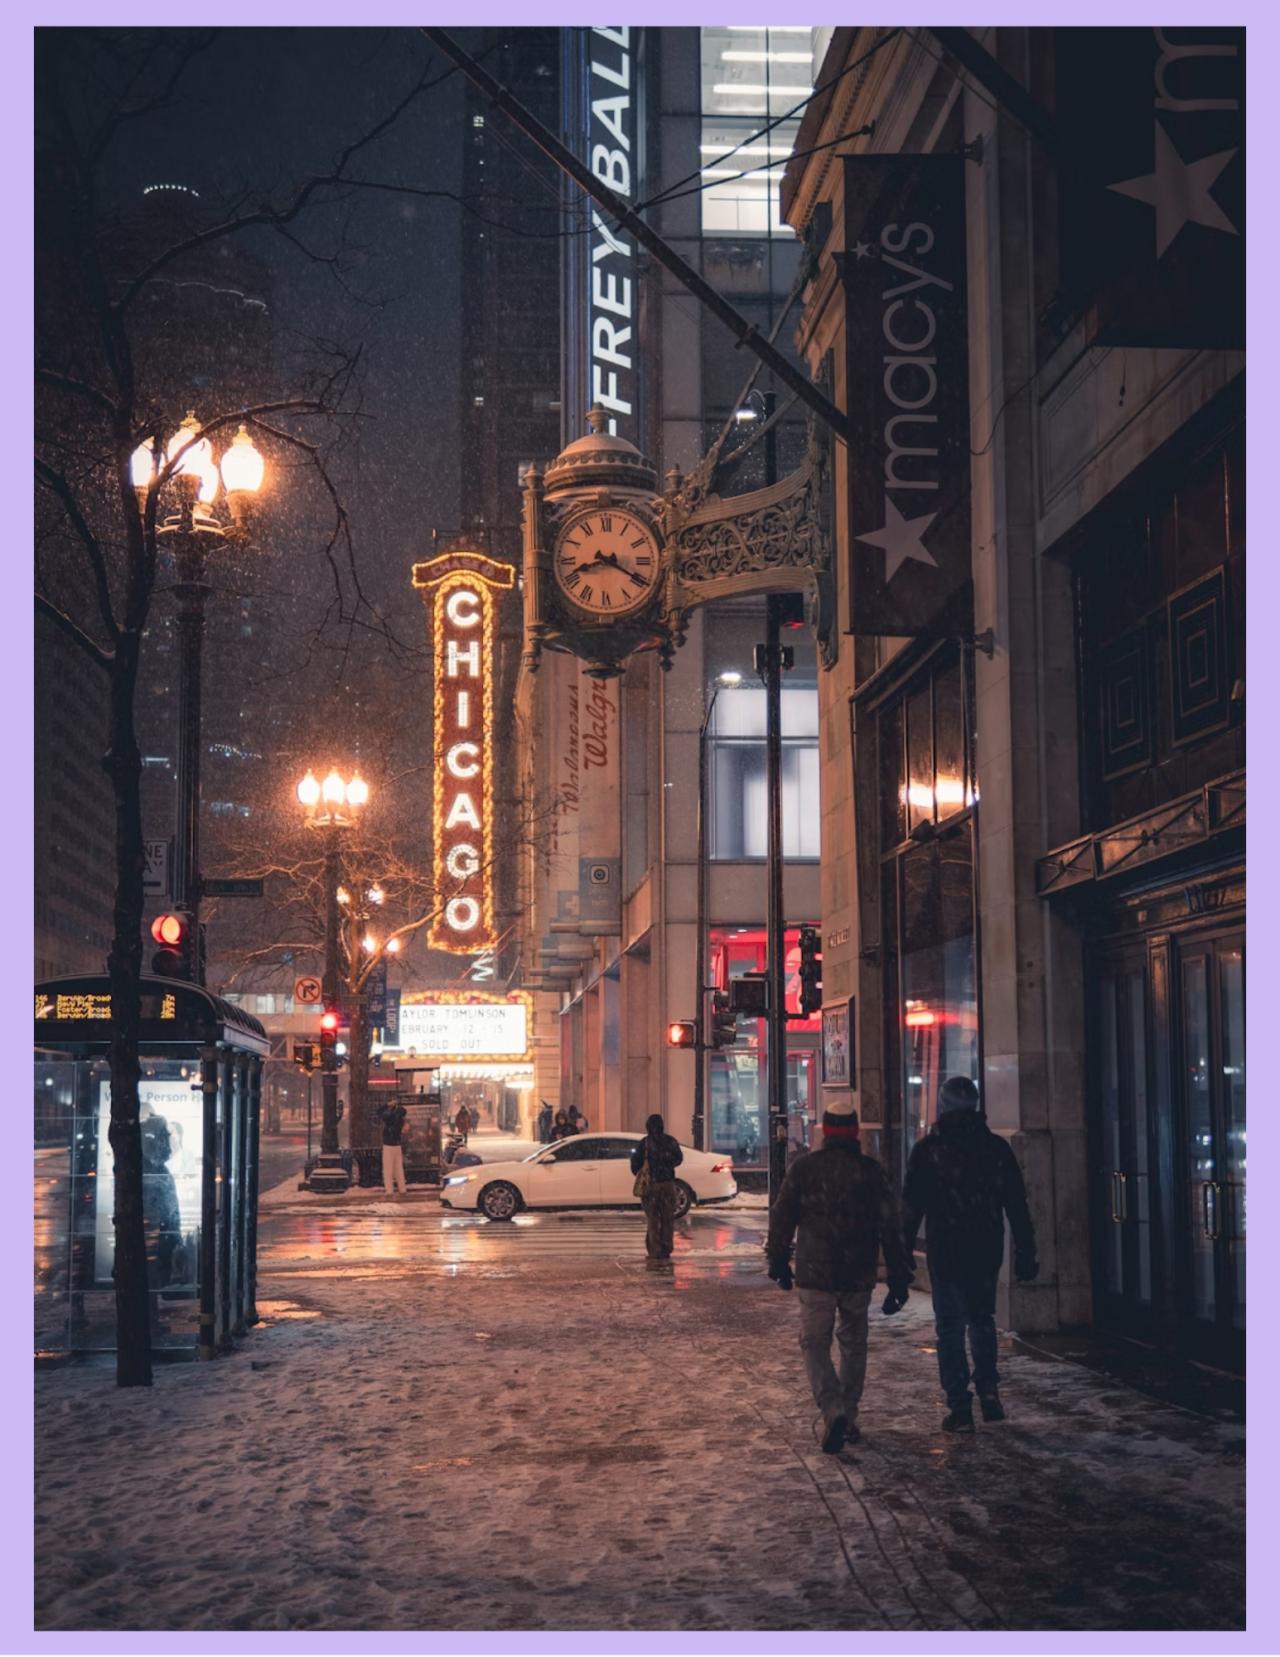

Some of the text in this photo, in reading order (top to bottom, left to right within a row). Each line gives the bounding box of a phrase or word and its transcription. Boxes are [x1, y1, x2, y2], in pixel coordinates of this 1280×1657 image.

[592, 209, 631, 437] FREY
[582, 678, 617, 770] Walgr
[446, 591, 480, 930] CHICAGO
[144, 845, 163, 858] NE
[402, 1009, 506, 1018] AYLOR TOMLINSON
[402, 1024, 448, 1034] EBRUARY
[147, 1091, 187, 1102] Person
